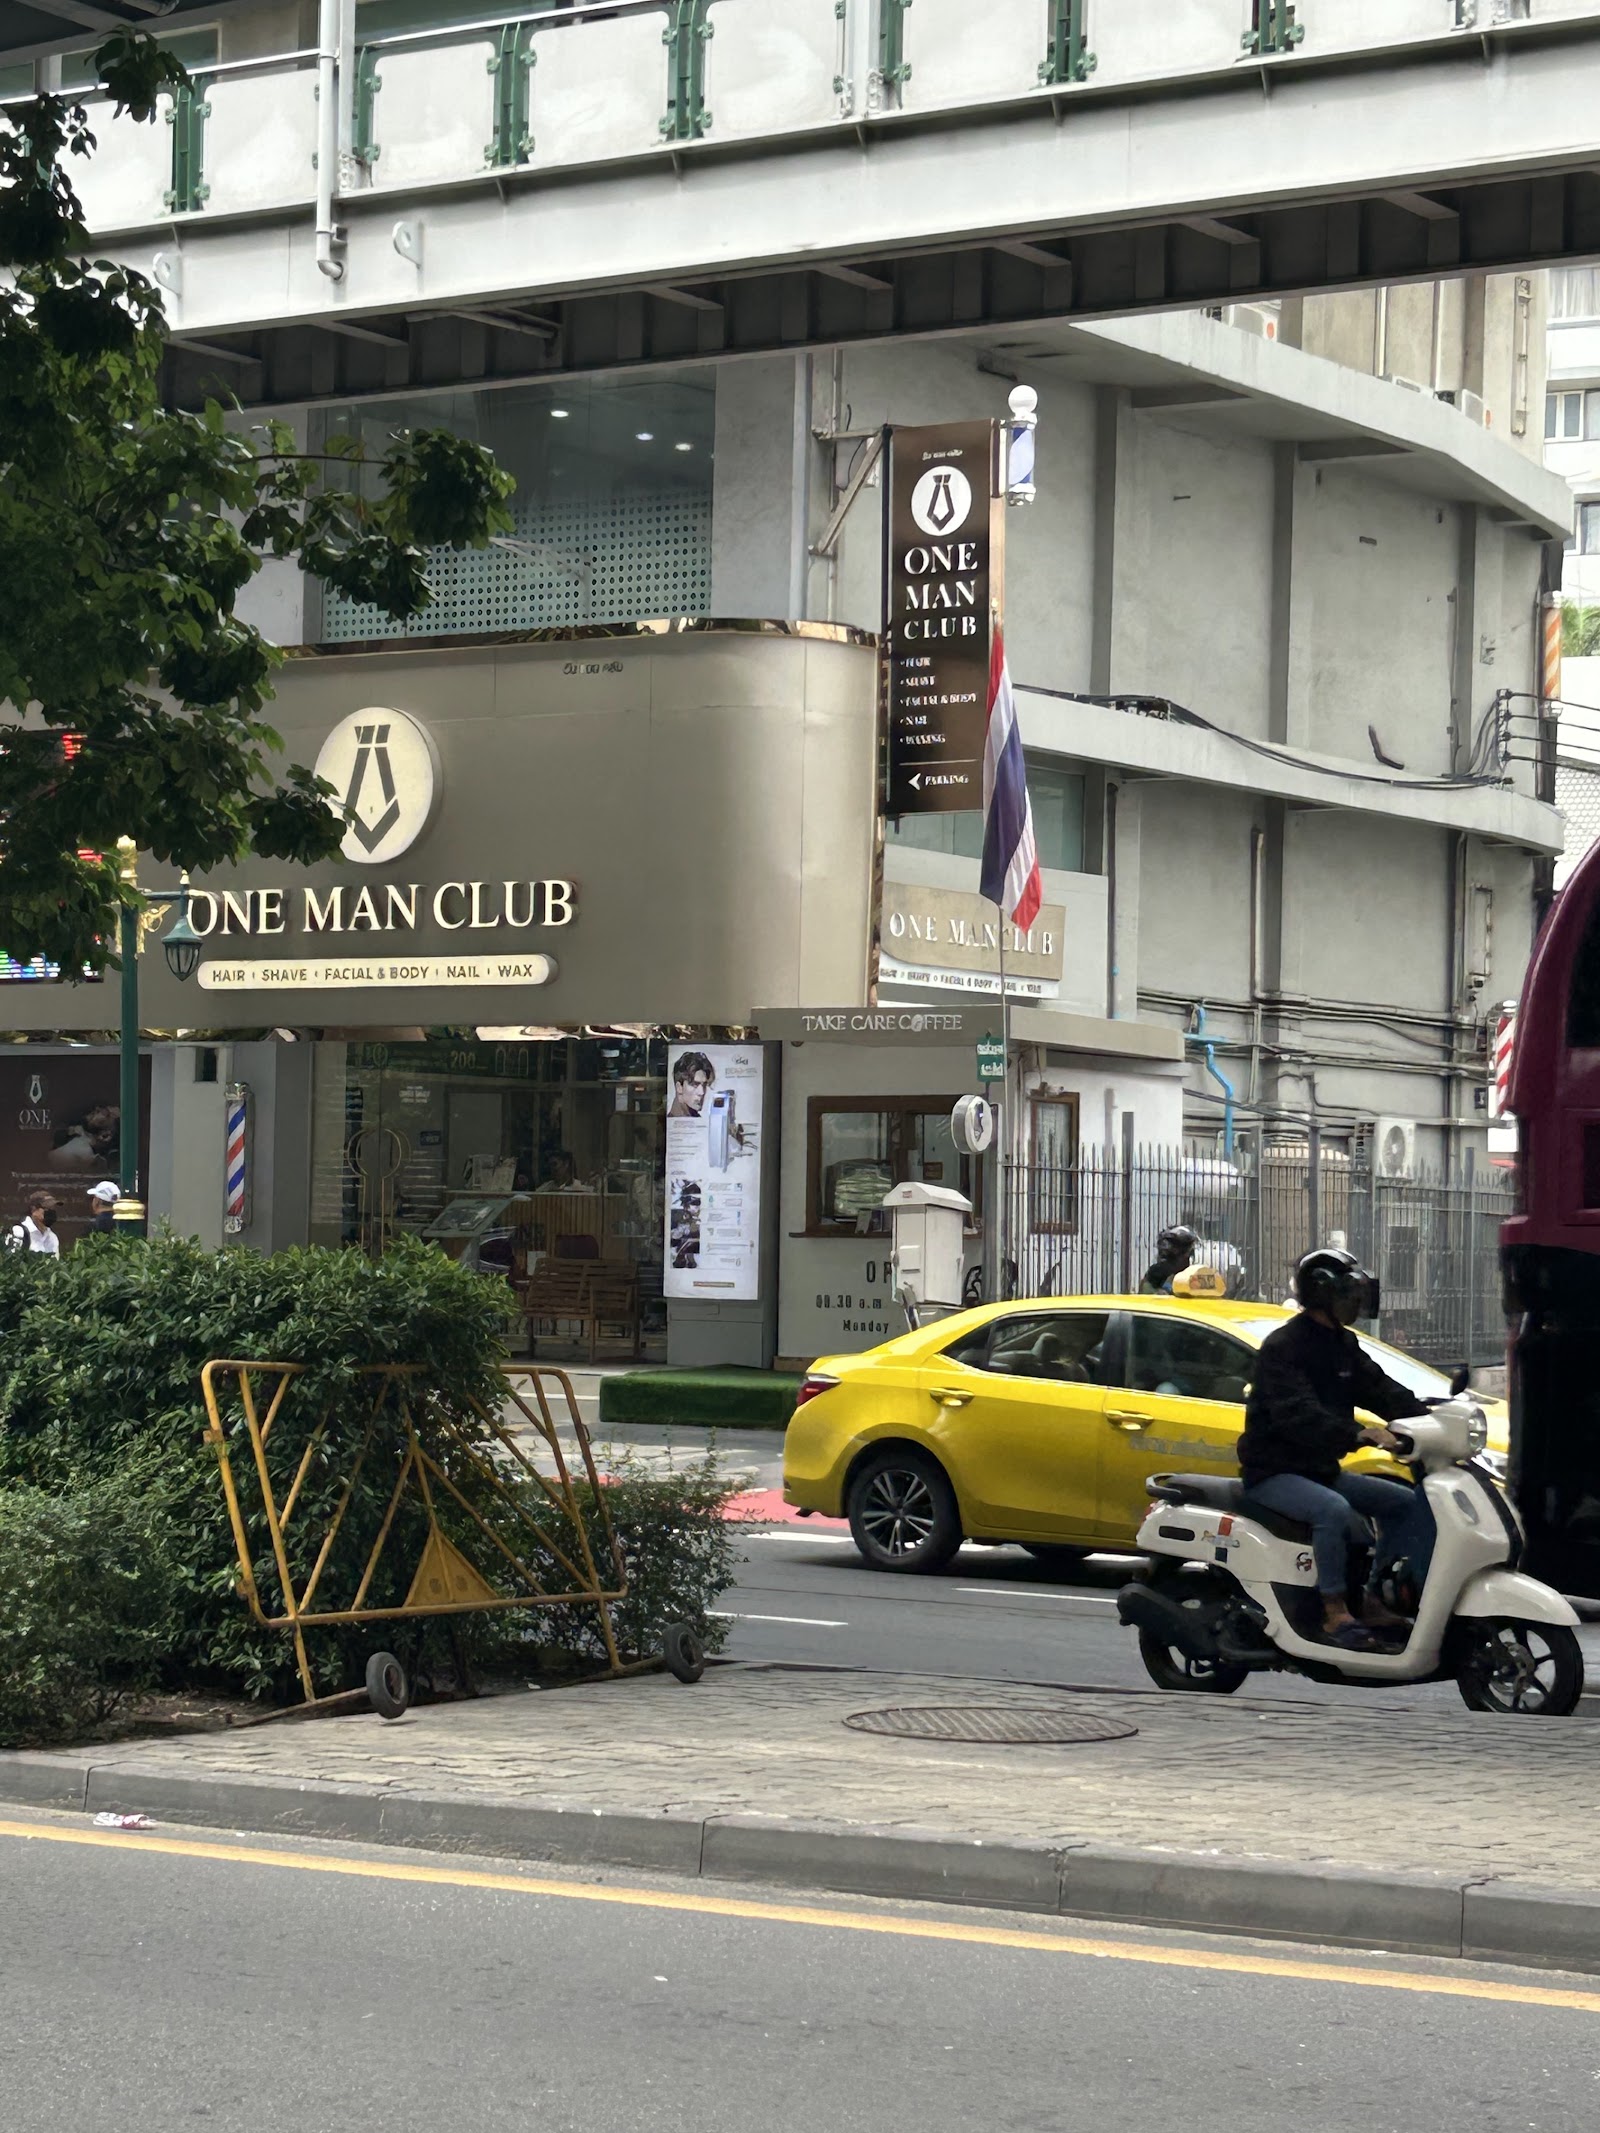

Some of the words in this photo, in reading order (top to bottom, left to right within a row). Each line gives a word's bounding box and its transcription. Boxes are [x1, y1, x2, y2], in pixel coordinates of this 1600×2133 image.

[904, 542, 978, 575] ONE
[905, 580, 976, 611] MAN
[903, 616, 977, 640] CLUB
[187, 888, 286, 936] ONE
[302, 883, 421, 933] MAN
[433, 880, 574, 930] CLUB
[889, 912, 938, 942] ONE
[948, 918, 998, 949] MAN
[212, 969, 245, 982] HAIR
[261, 968, 308, 982] SHAVE
[324, 967, 374, 981] FACIAL
[377, 967, 386, 980] &
[390, 966, 429, 979] BODY
[447, 965, 480, 978] NAIL
[498, 964, 533, 978] WAX
[802, 1014, 847, 1031] TAKE
[850, 1014, 896, 1031] CARE
[898, 1013, 963, 1032] COFFEE
[843, 1319, 889, 1334] Monday
